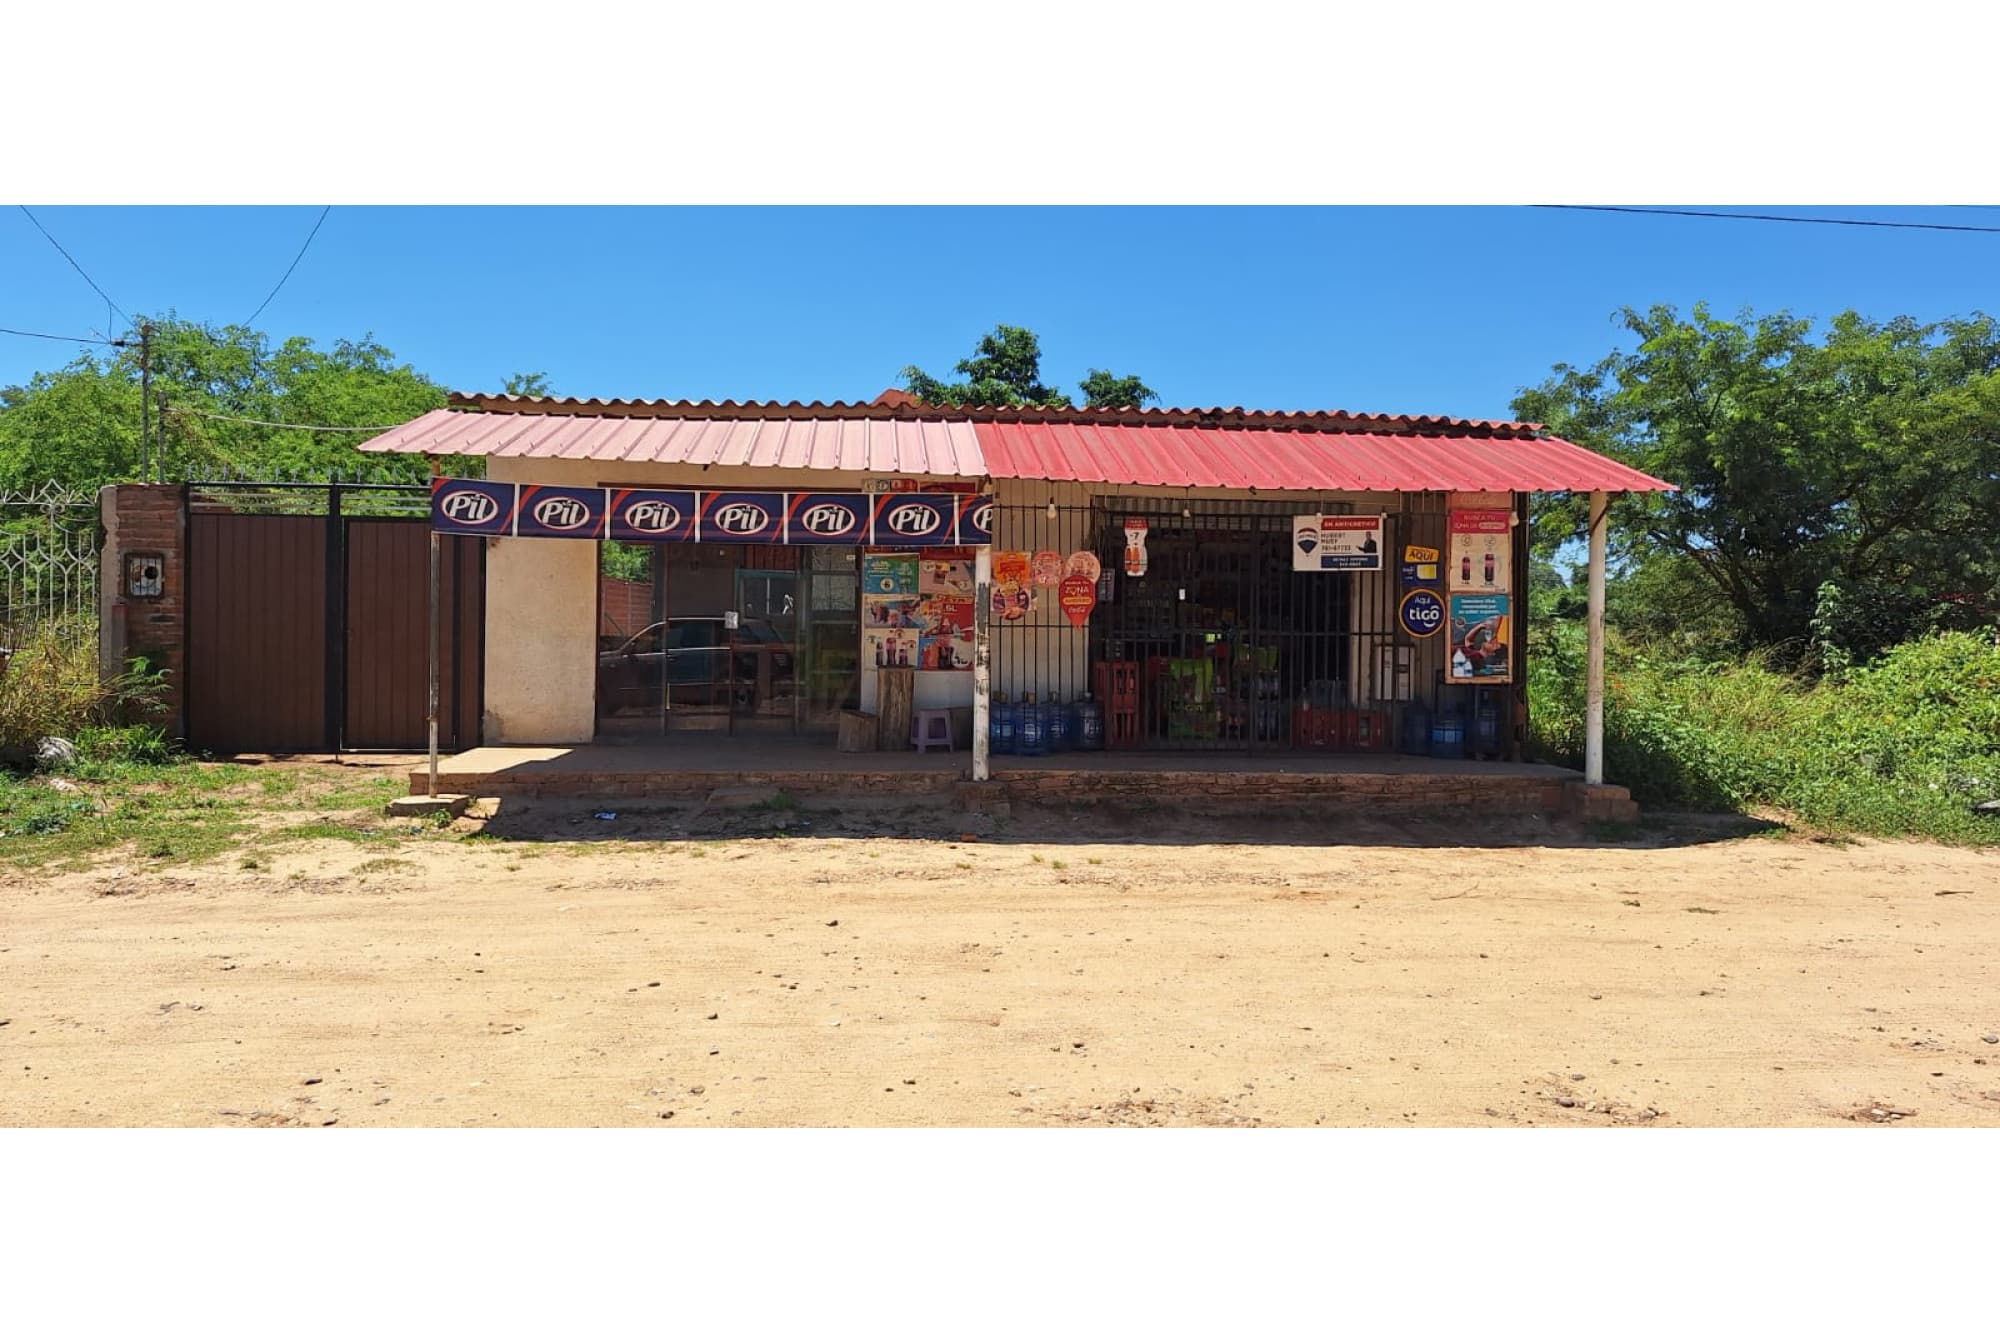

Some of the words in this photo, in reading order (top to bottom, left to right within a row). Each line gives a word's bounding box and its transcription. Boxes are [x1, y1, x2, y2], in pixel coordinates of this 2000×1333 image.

[449, 493, 486, 519] Pil
[542, 499, 578, 525] Pil
[633, 503, 669, 528] Pil
[724, 505, 758, 531] Pil
[811, 506, 844, 531] Pil
[897, 506, 929, 531] Pil
